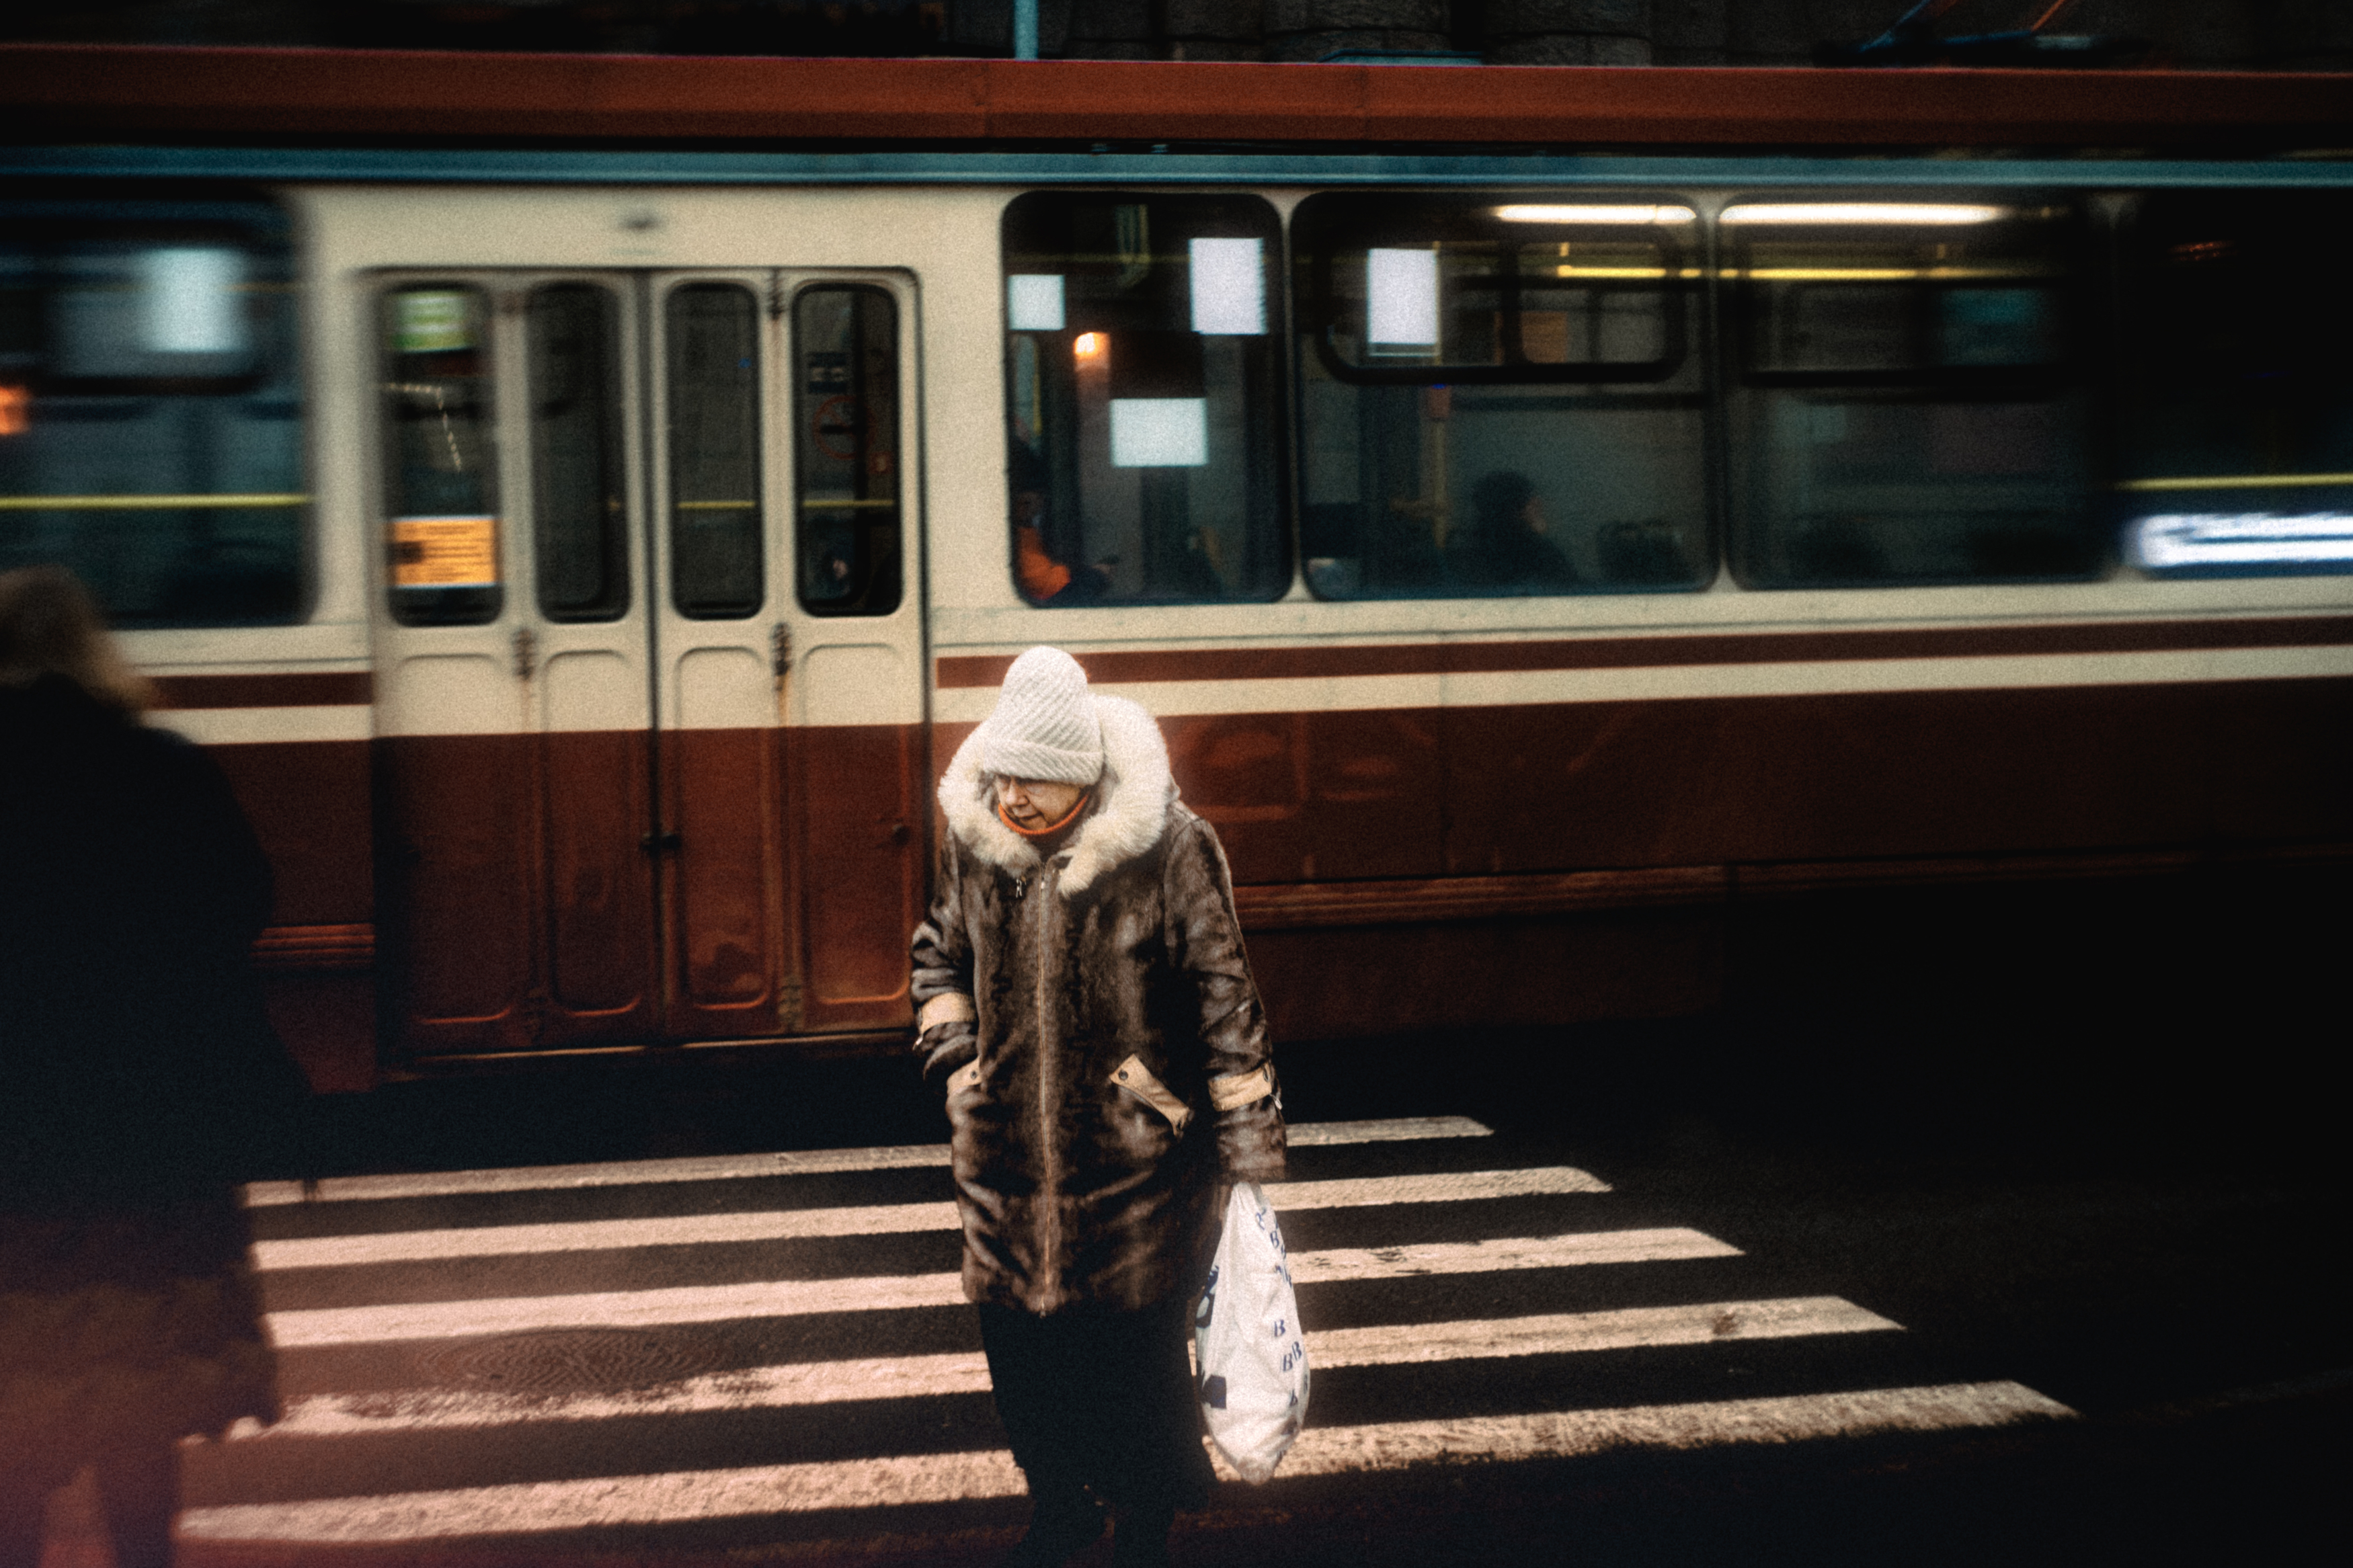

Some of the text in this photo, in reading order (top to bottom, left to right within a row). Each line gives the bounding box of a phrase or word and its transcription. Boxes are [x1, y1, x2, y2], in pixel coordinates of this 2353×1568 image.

[1269, 1230, 1279, 1249] B
[1273, 1319, 1285, 1337] B
[1291, 1341, 1302, 1361] B
[1281, 1352, 1293, 1371] B
